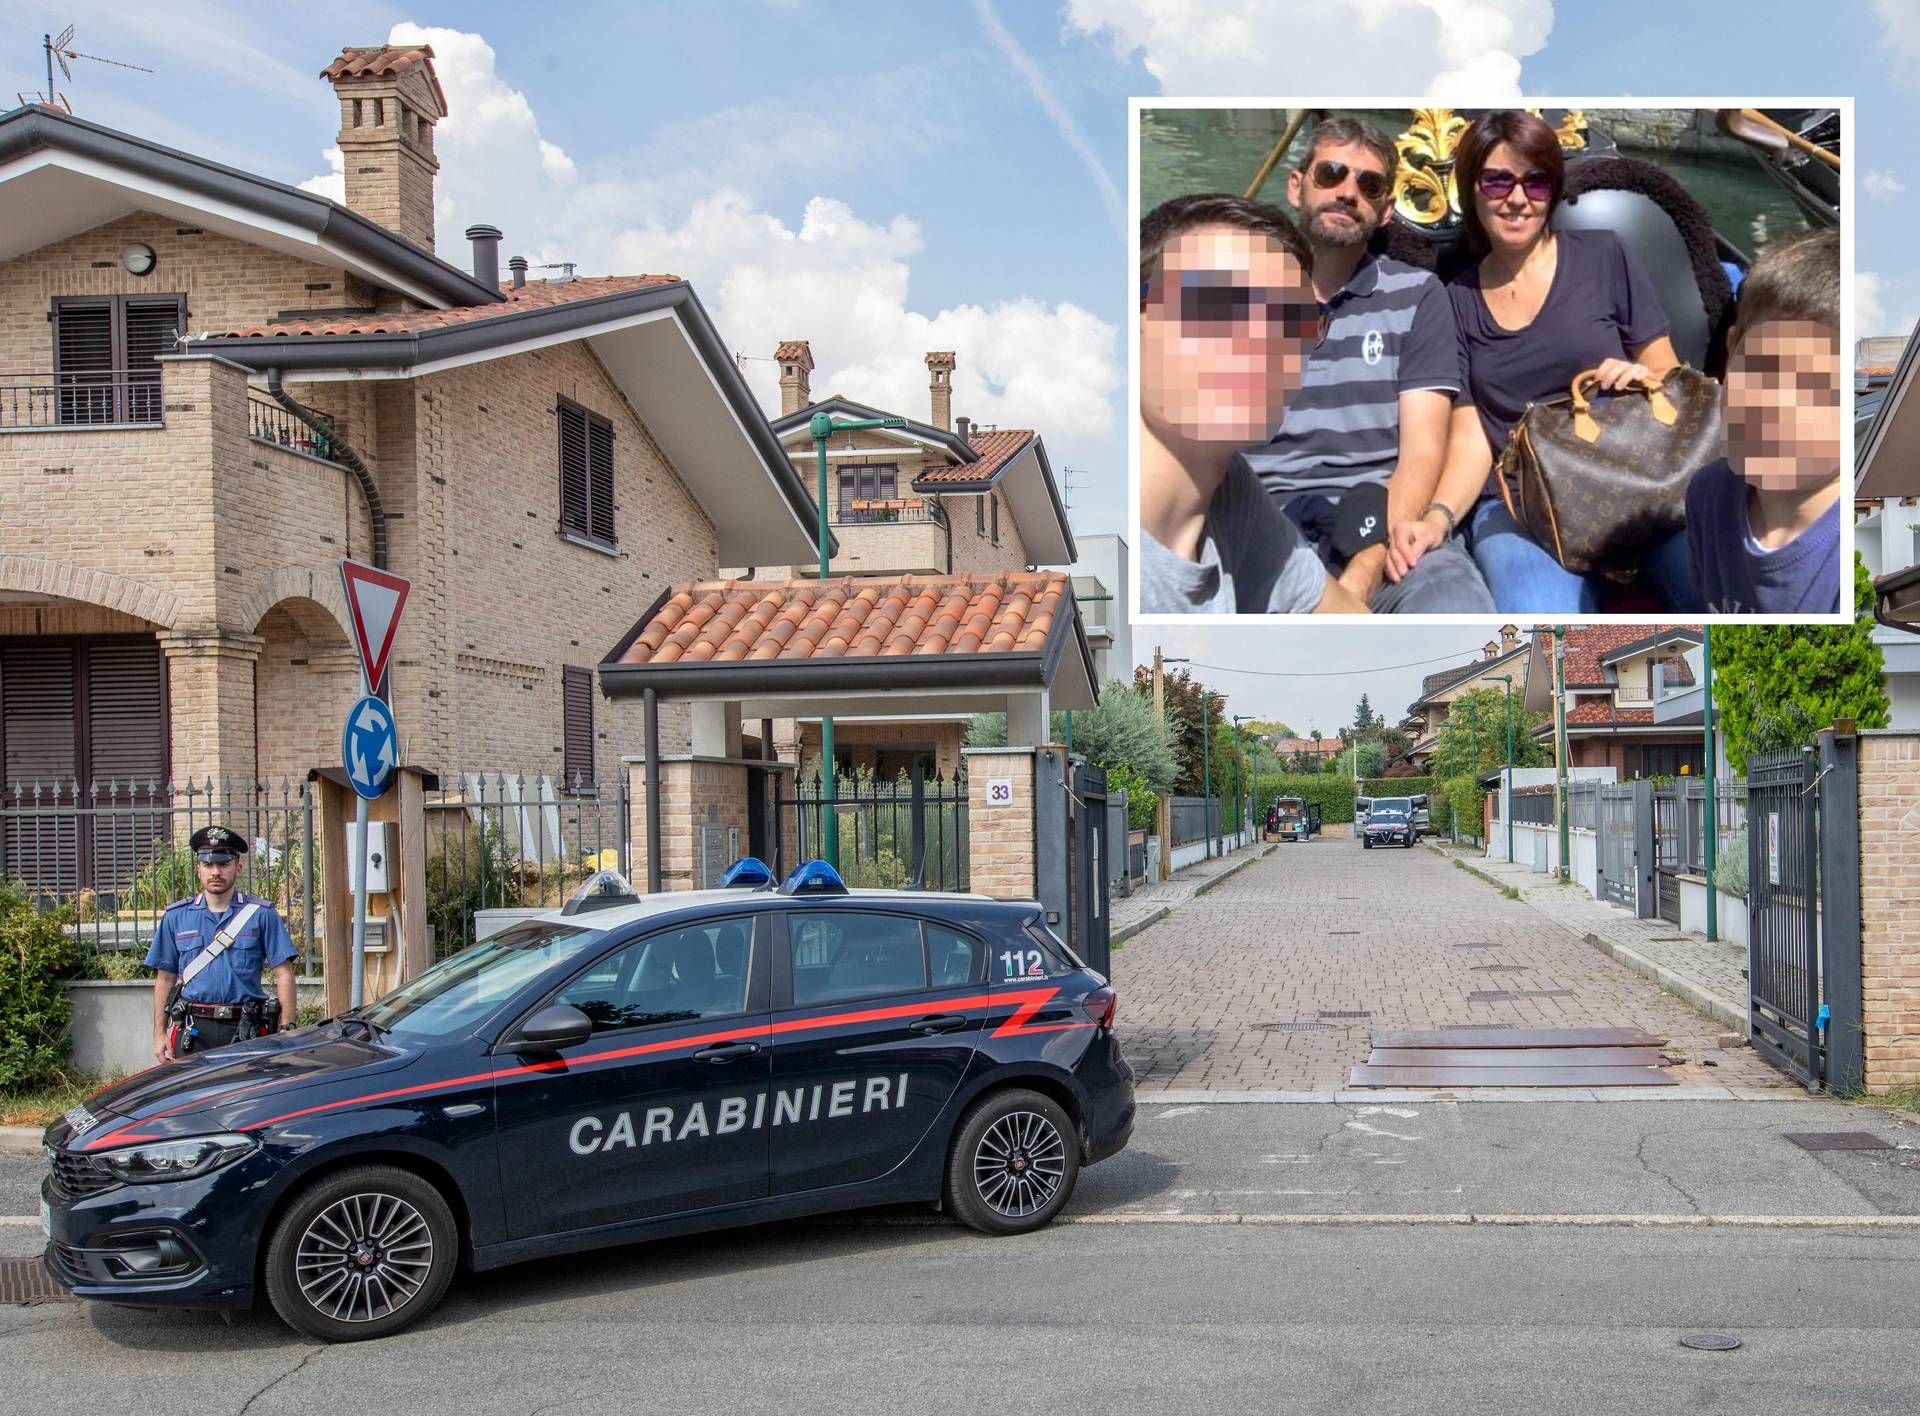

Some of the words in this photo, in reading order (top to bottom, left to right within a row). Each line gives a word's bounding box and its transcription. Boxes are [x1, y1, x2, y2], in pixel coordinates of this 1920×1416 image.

[992, 785, 1009, 799] 33
[1000, 950, 1044, 976] 112
[569, 1073, 909, 1154] CARABINIERI
